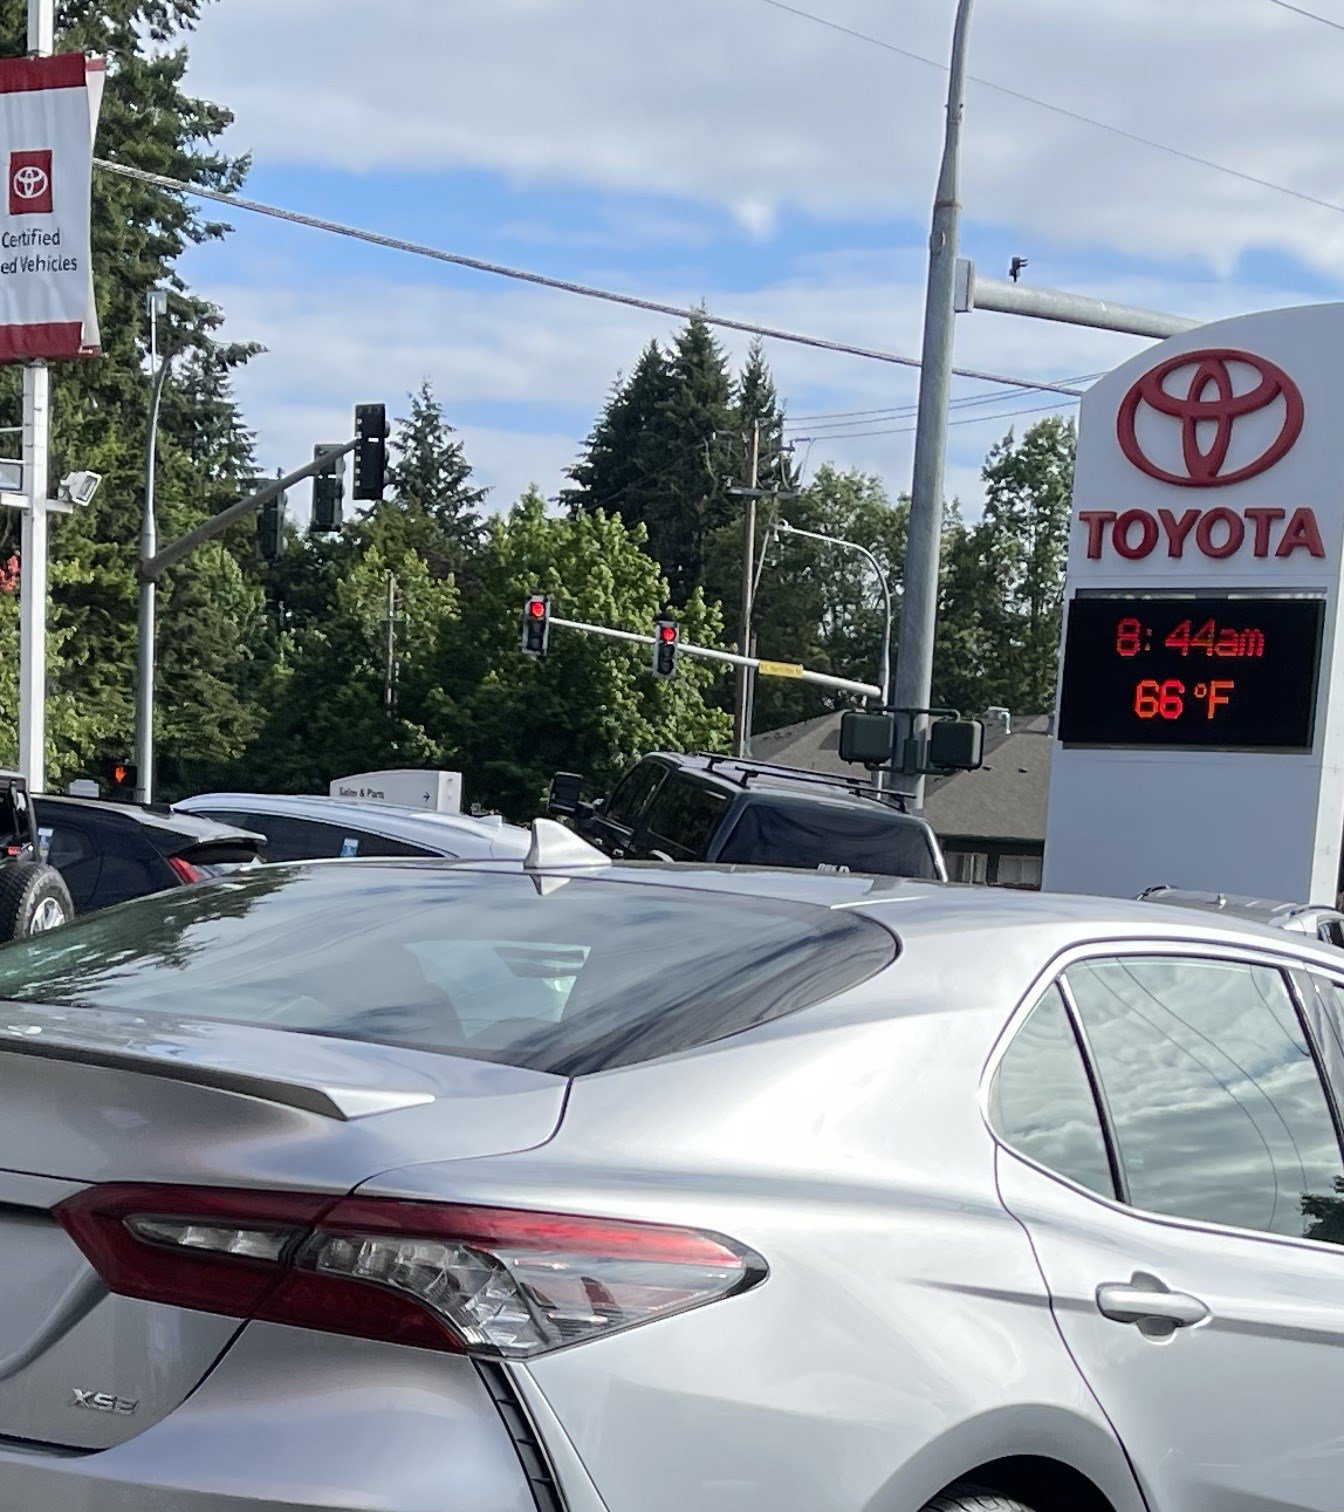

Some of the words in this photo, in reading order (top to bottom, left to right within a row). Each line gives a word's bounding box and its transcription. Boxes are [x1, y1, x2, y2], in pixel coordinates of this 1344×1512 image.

[1, 227, 60, 248] Certified
[20, 254, 78, 273] Vehicles
[1079, 506, 1326, 560] TOYOTA
[367, 788, 385, 799] Parts
[72, 1388, 139, 1416] XSE
